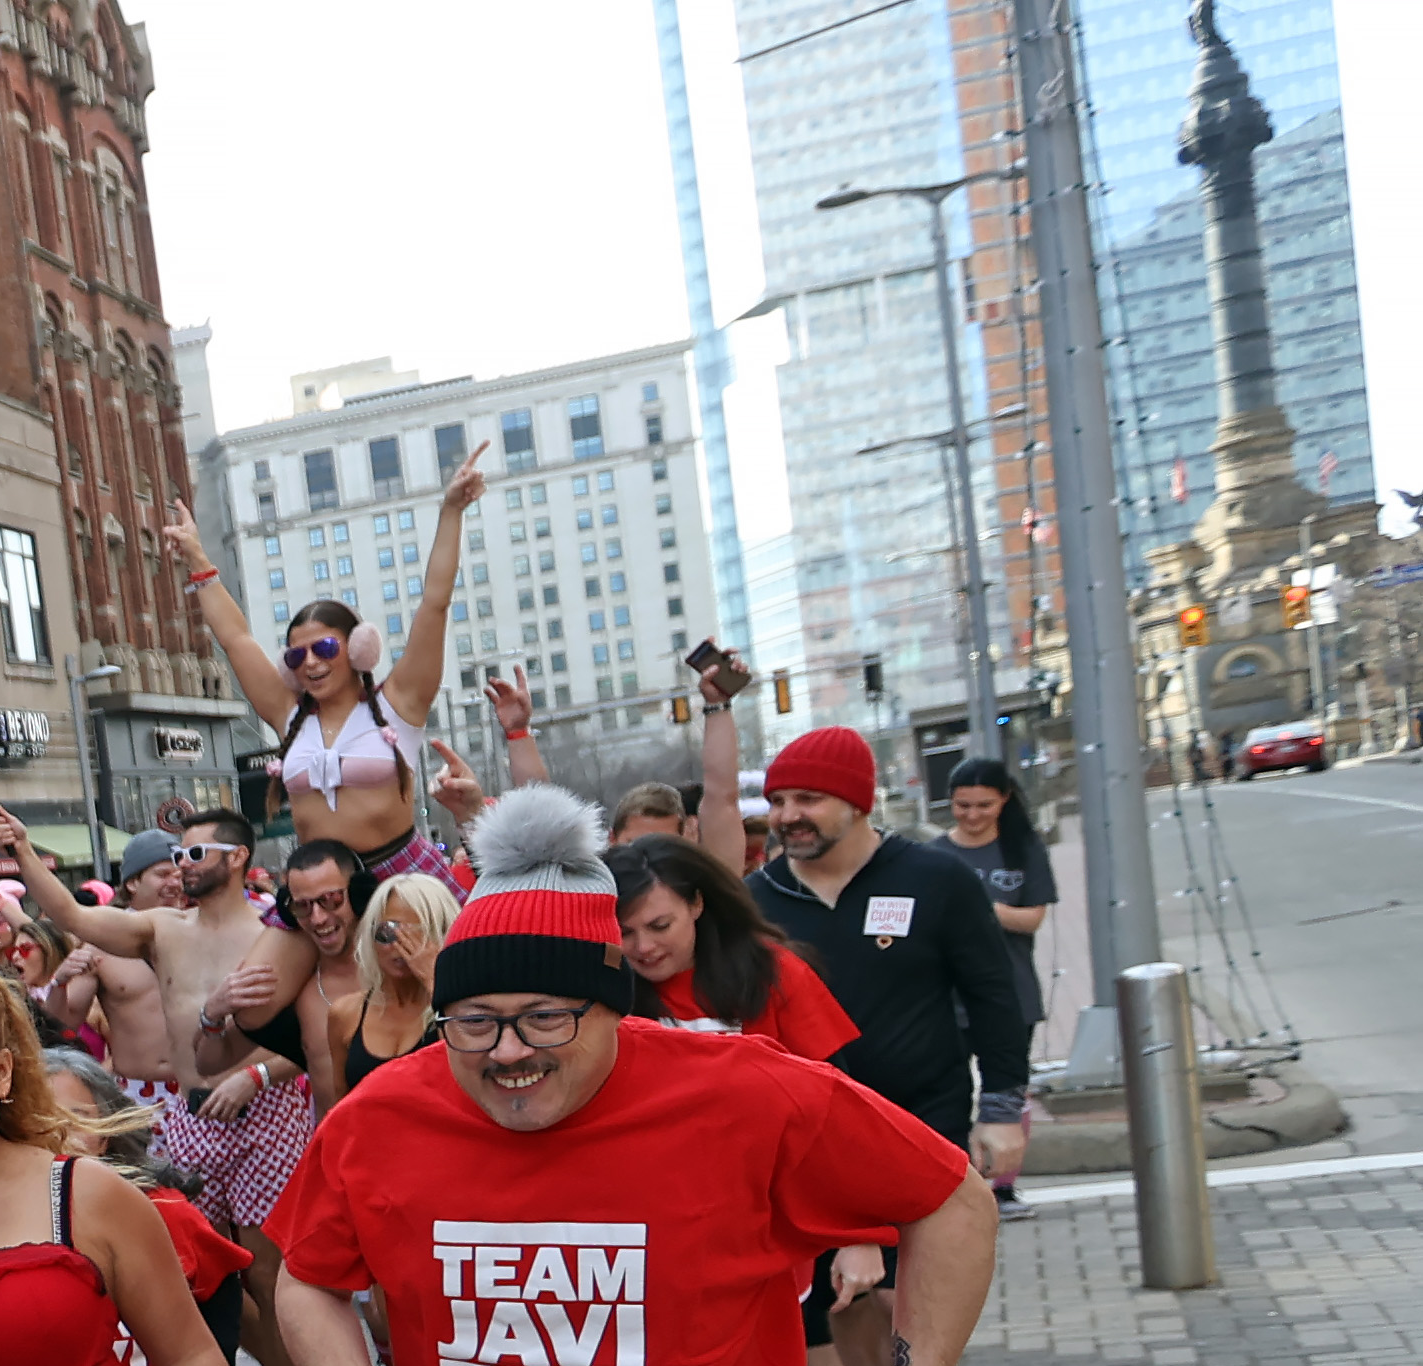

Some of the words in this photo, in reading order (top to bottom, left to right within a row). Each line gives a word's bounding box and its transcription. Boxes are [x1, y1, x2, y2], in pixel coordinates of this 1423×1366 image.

[7, 710, 50, 743] BEYOND
[870, 910, 908, 923] CUPID
[432, 1244, 646, 1302] TEAM
